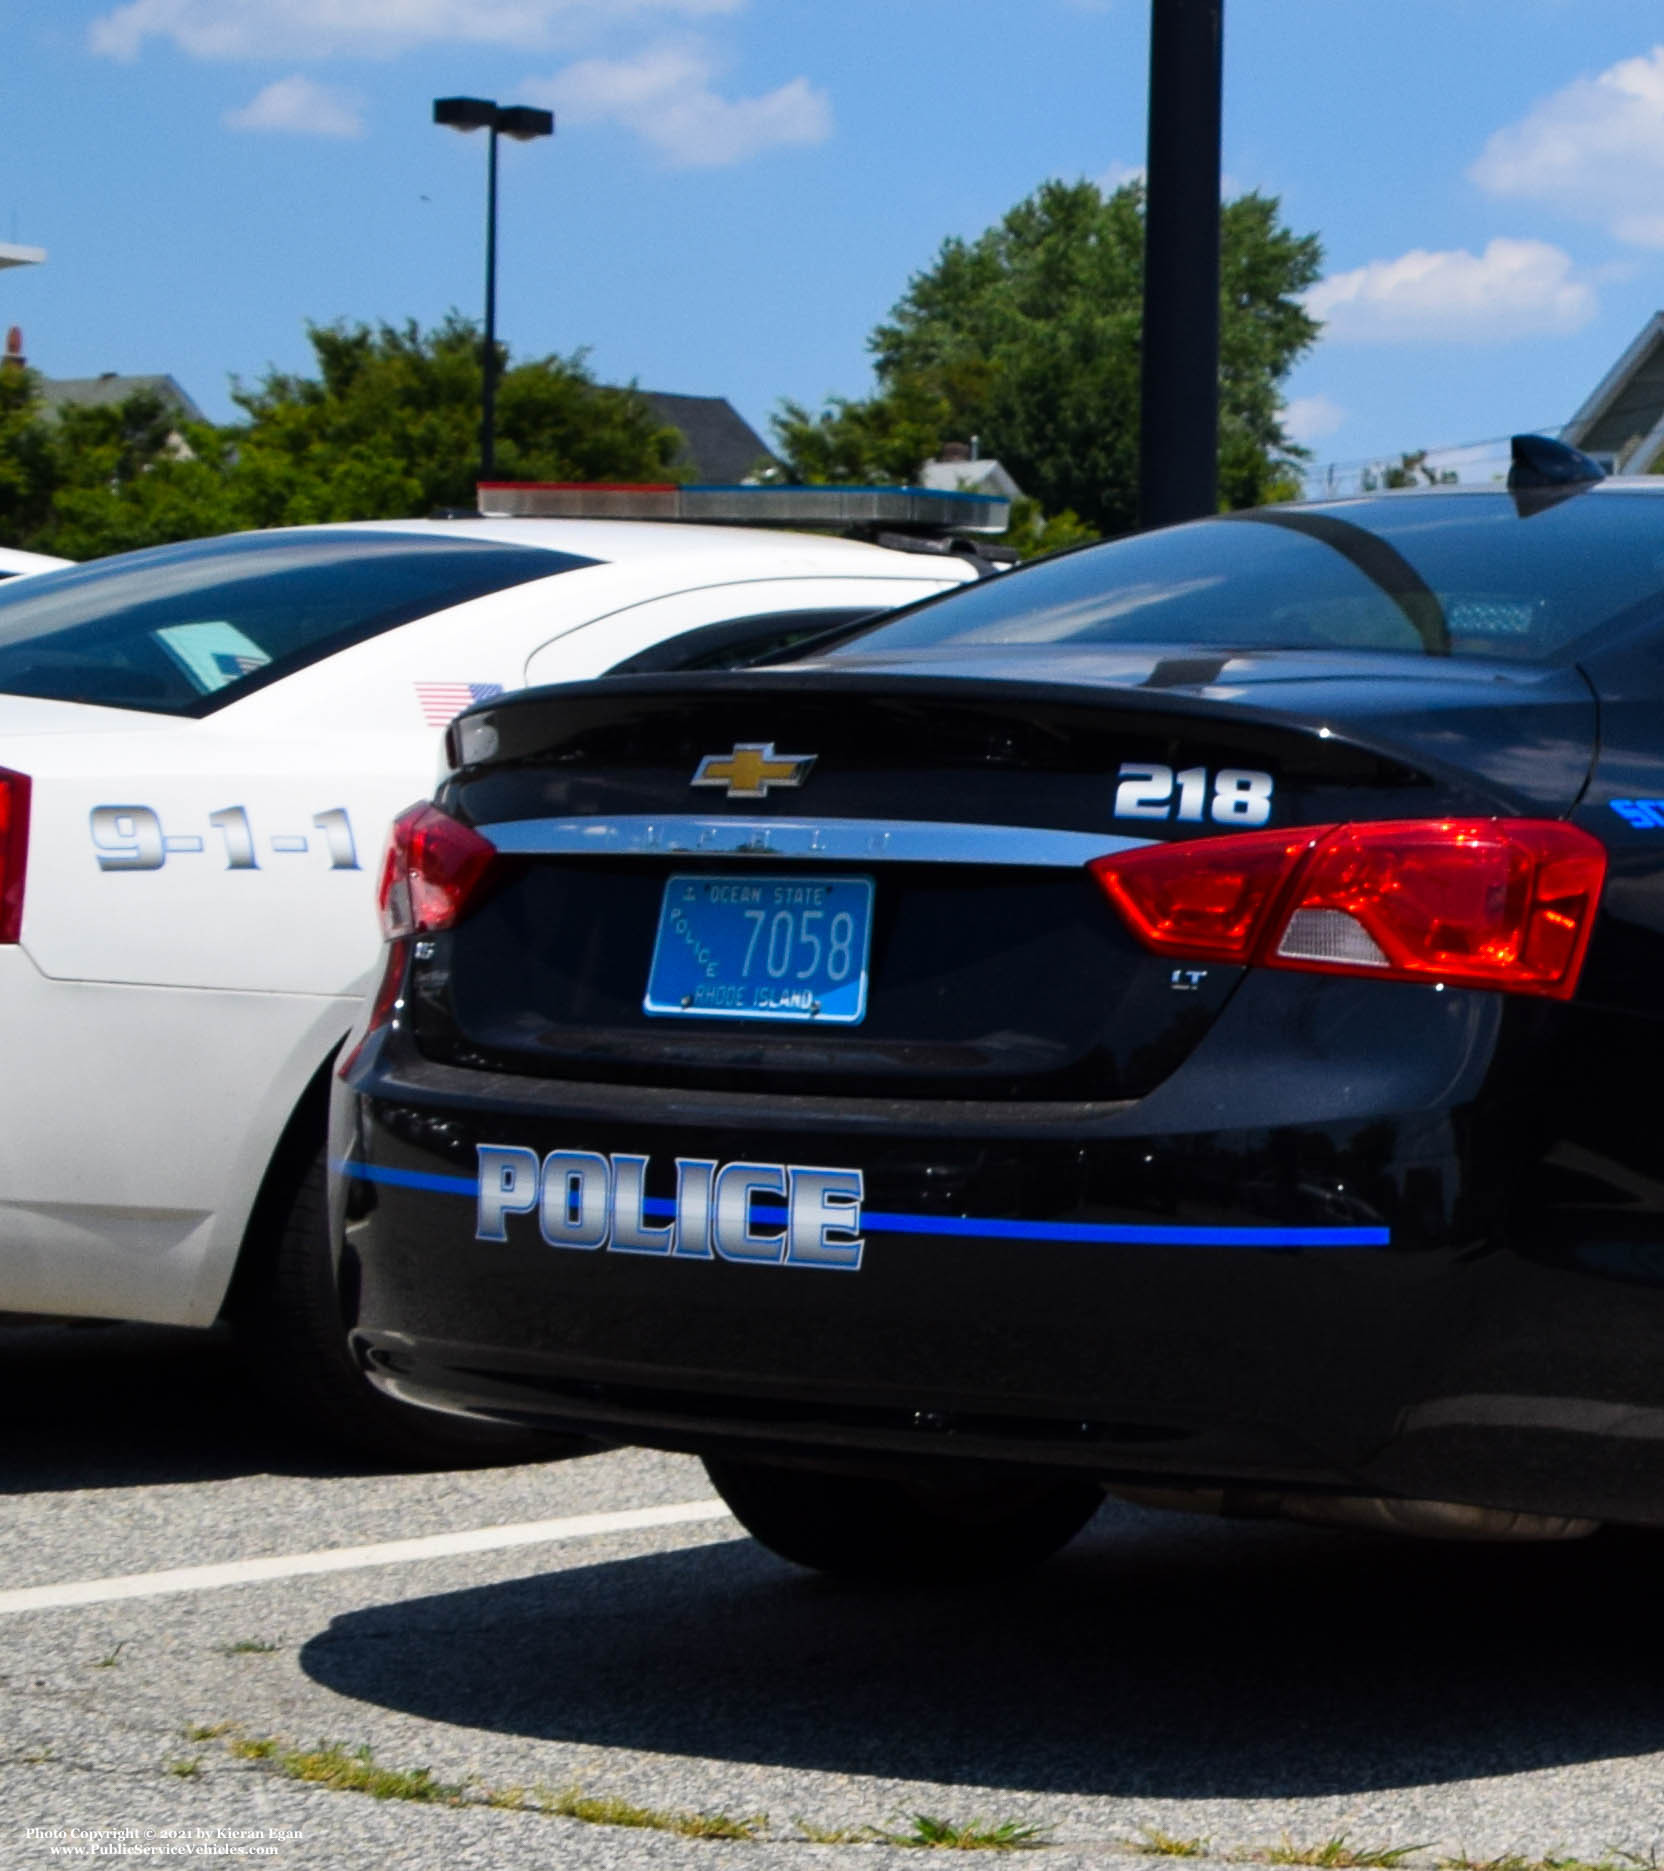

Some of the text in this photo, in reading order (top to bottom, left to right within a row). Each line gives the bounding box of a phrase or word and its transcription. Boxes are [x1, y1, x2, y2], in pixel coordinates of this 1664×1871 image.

[1114, 762, 1274, 827] 218
[89, 804, 363, 872] 9-1-1
[710, 886, 824, 905] OCEAN STATE
[670, 908, 719, 977] POLICE
[742, 909, 854, 981] 7058
[694, 984, 814, 1010] RHODE ISLAND
[476, 1144, 865, 1271] POLICE
